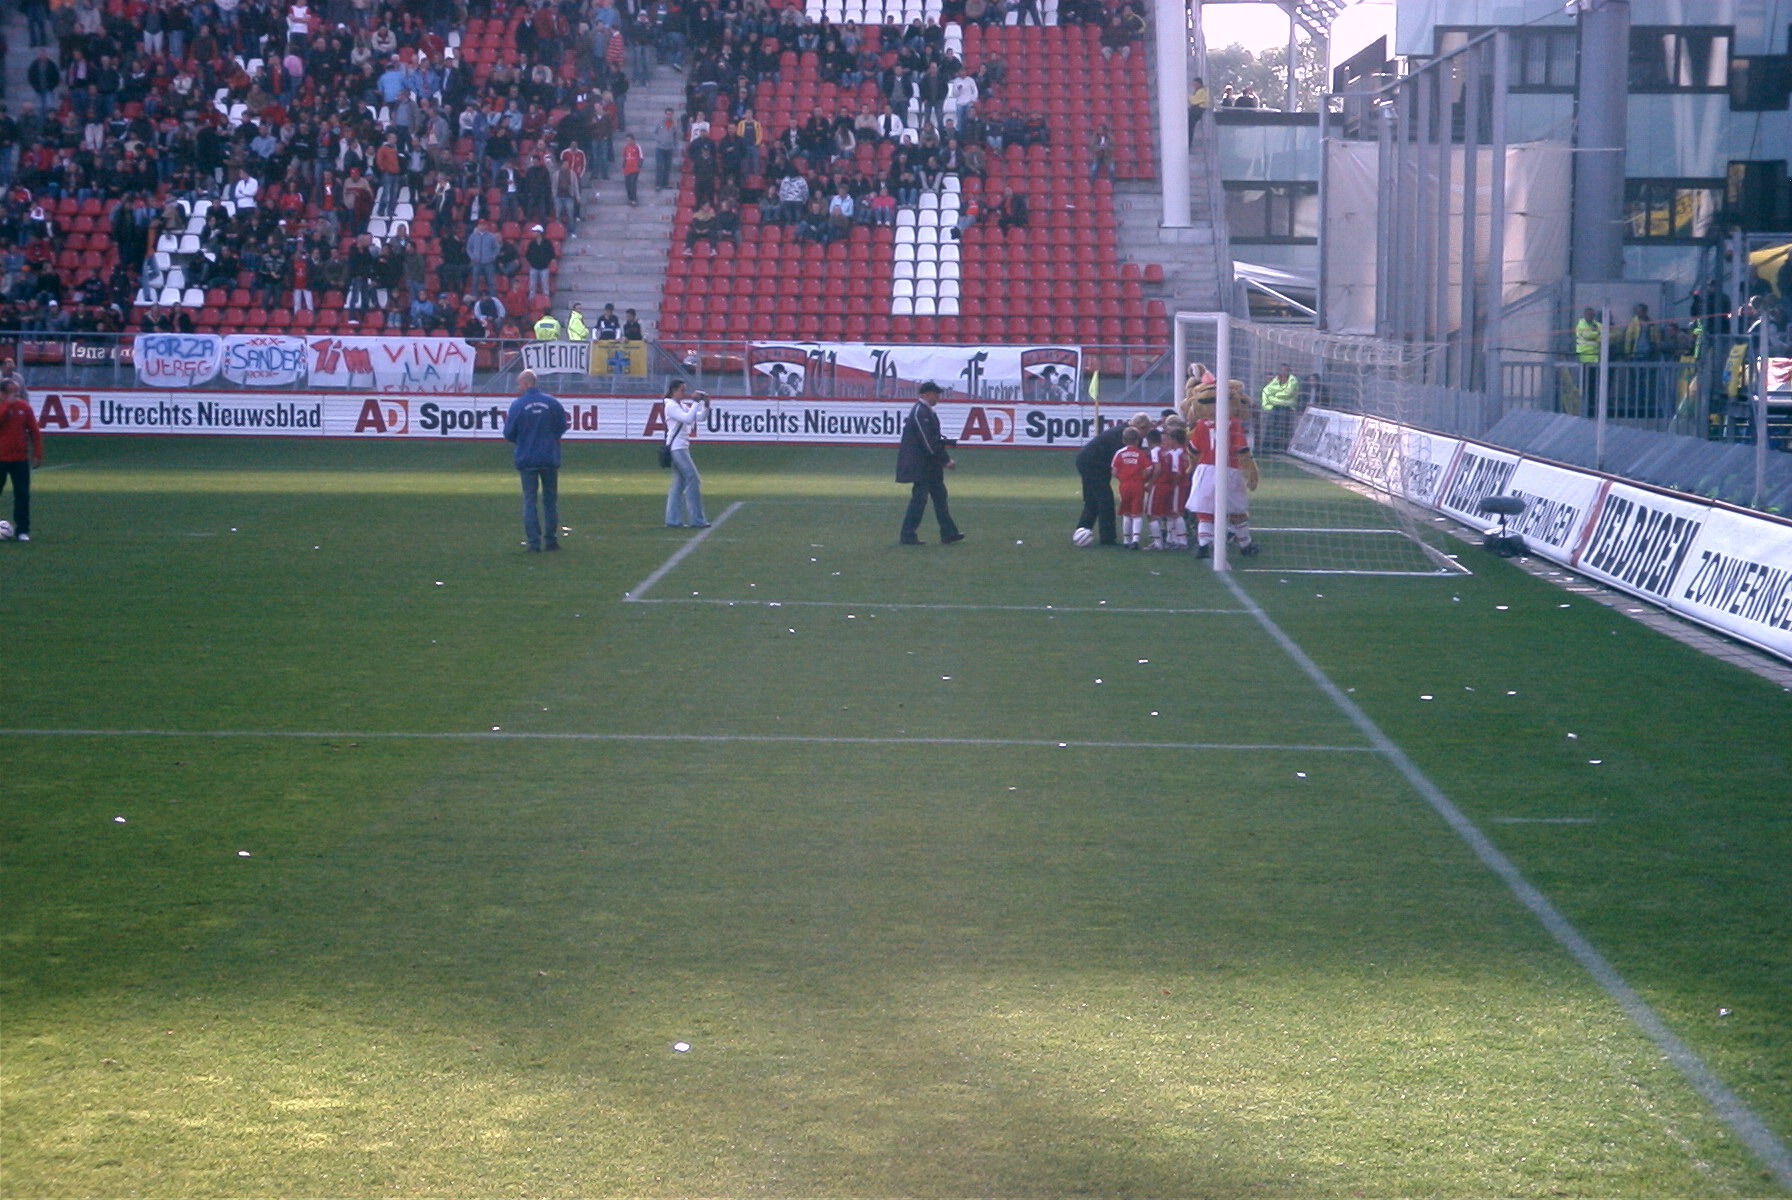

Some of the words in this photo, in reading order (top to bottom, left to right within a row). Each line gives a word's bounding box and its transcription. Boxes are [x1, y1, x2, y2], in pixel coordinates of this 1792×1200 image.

[231, 344, 301, 371] SANDER
[310, 338, 374, 374] Tim
[383, 342, 467, 365] VIVA
[405, 362, 441, 382] LA
[39, 394, 91, 429] AD
[100, 400, 193, 426] Utrechts
[198, 402, 321, 428] Nieuwsblad
[354, 399, 409, 434] AD
[419, 402, 598, 435] Sporteld
[643, 403, 697, 437] A
[707, 408, 799, 434] Utrechts
[804, 410, 909, 435] Nieuwsbl
[960, 407, 1016, 442] AD
[1583, 494, 1702, 598] VELDHOEN
